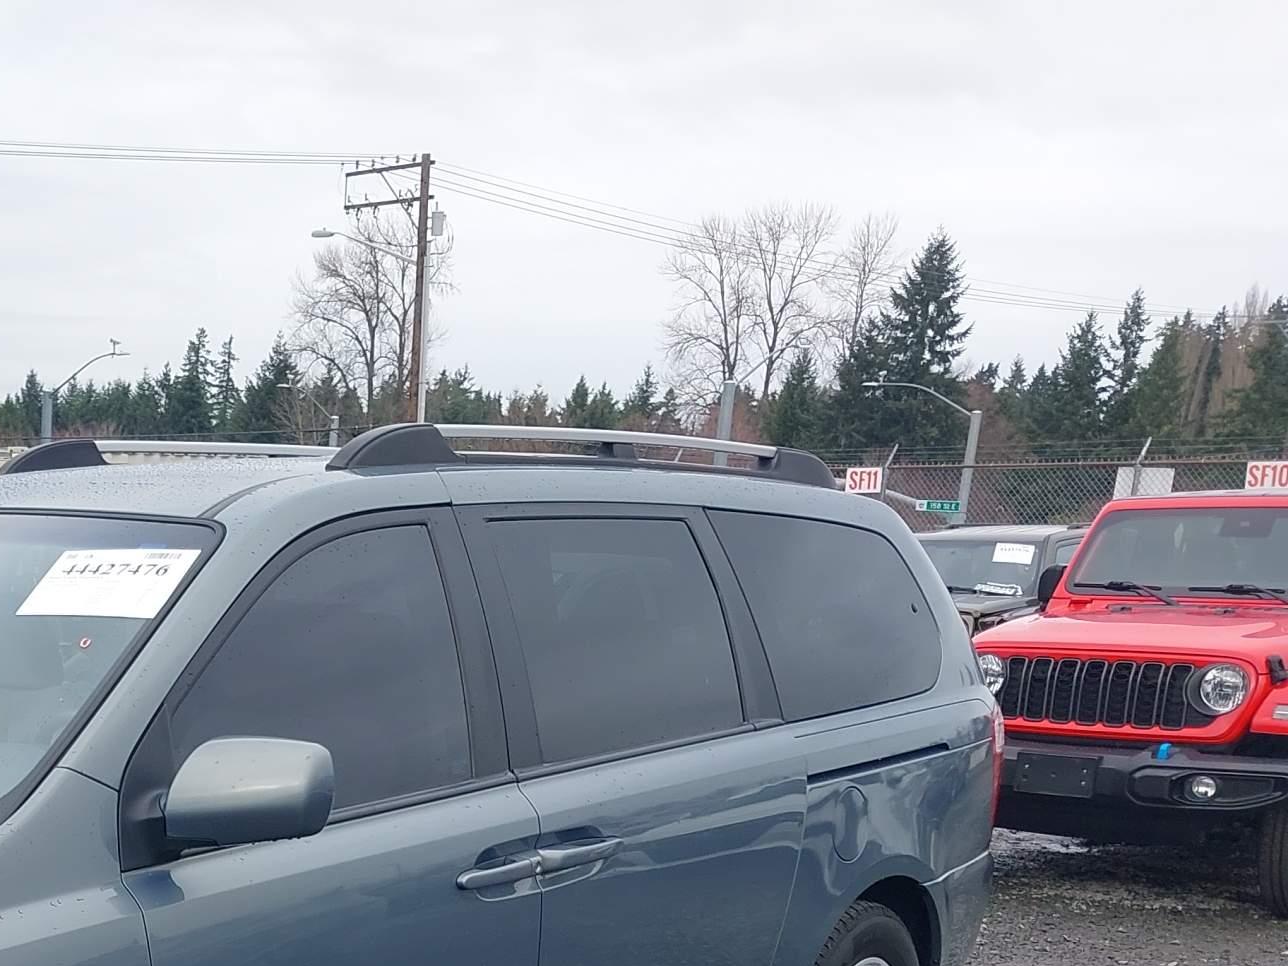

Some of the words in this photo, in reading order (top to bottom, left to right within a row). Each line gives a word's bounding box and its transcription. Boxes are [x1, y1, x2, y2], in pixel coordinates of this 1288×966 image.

[849, 470, 878, 490] SF11
[1248, 464, 1288, 487] SF10
[61, 563, 171, 577] 44427476
